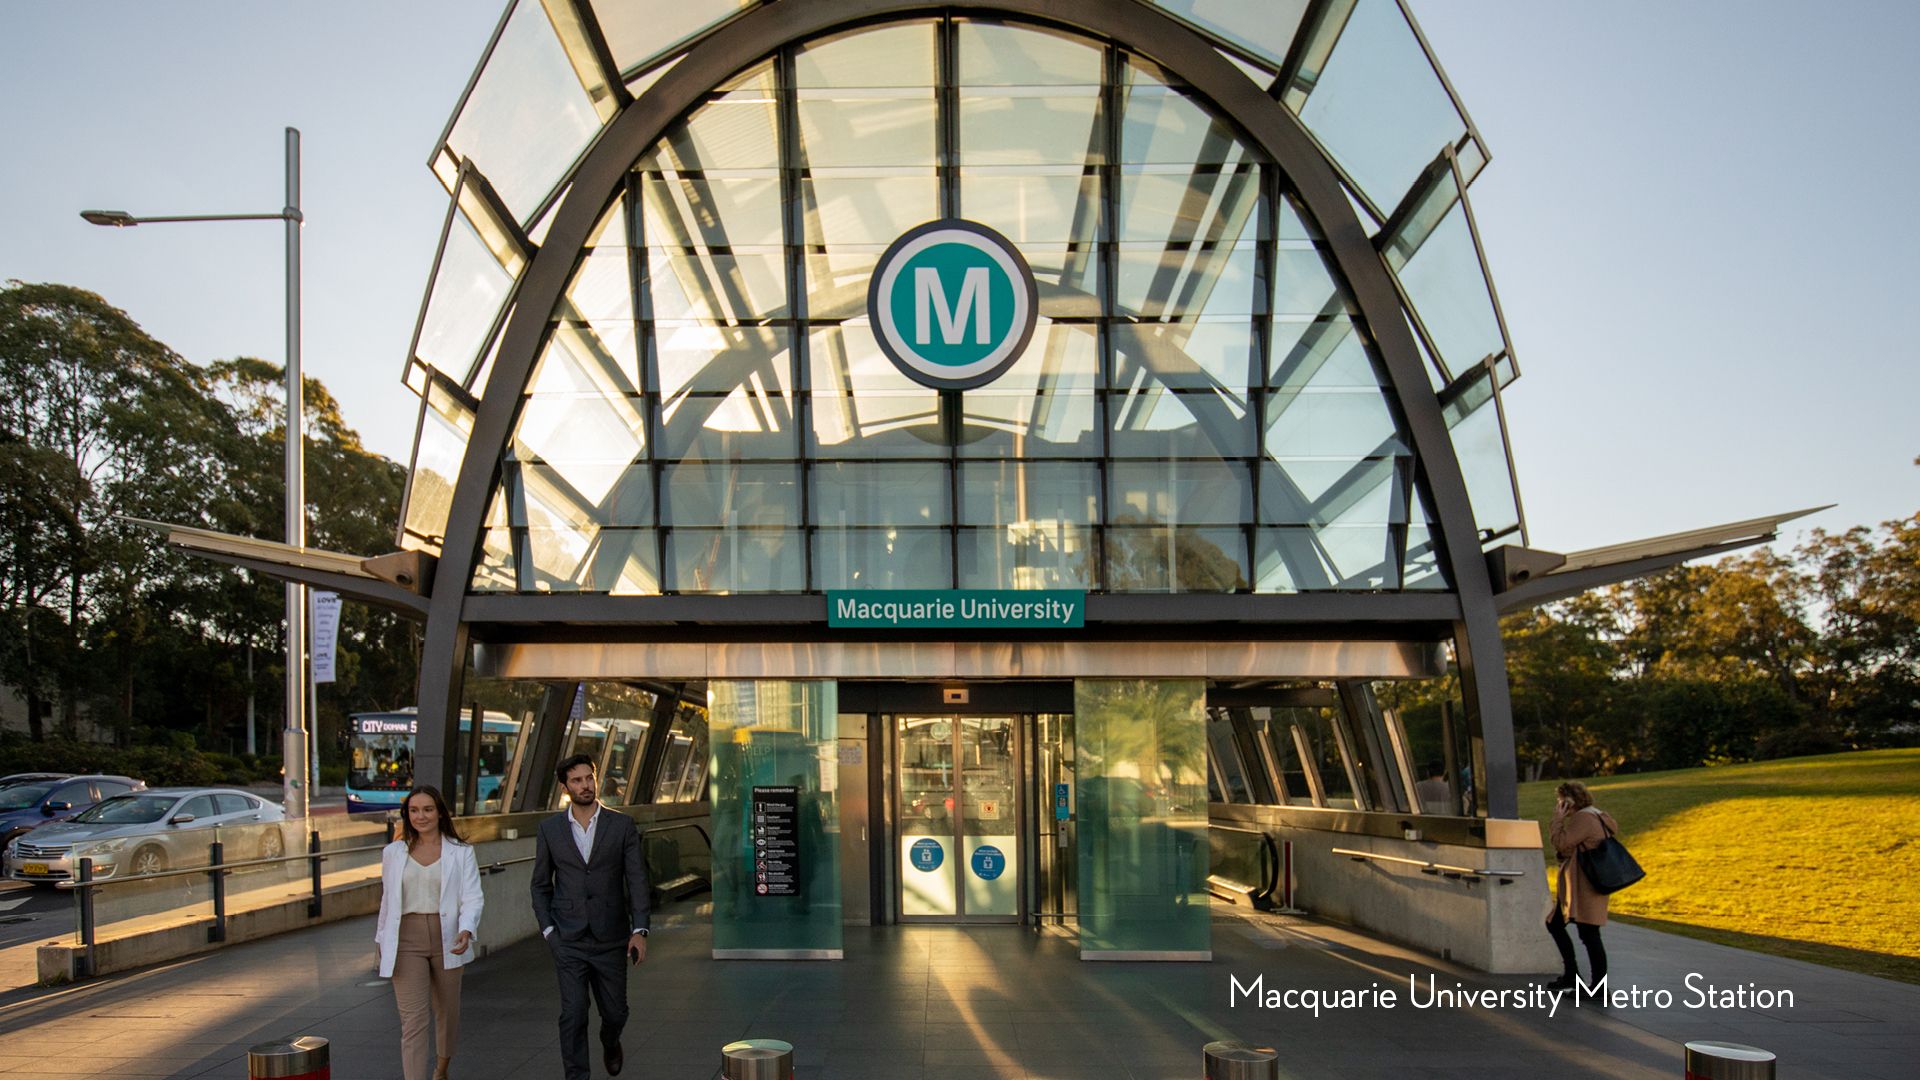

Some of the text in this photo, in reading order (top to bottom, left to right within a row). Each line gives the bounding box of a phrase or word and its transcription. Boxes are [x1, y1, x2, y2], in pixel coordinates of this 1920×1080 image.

[914, 267, 991, 345] M
[837, 598, 1075, 624] Macquarie University
[362, 720, 383, 733] CITY
